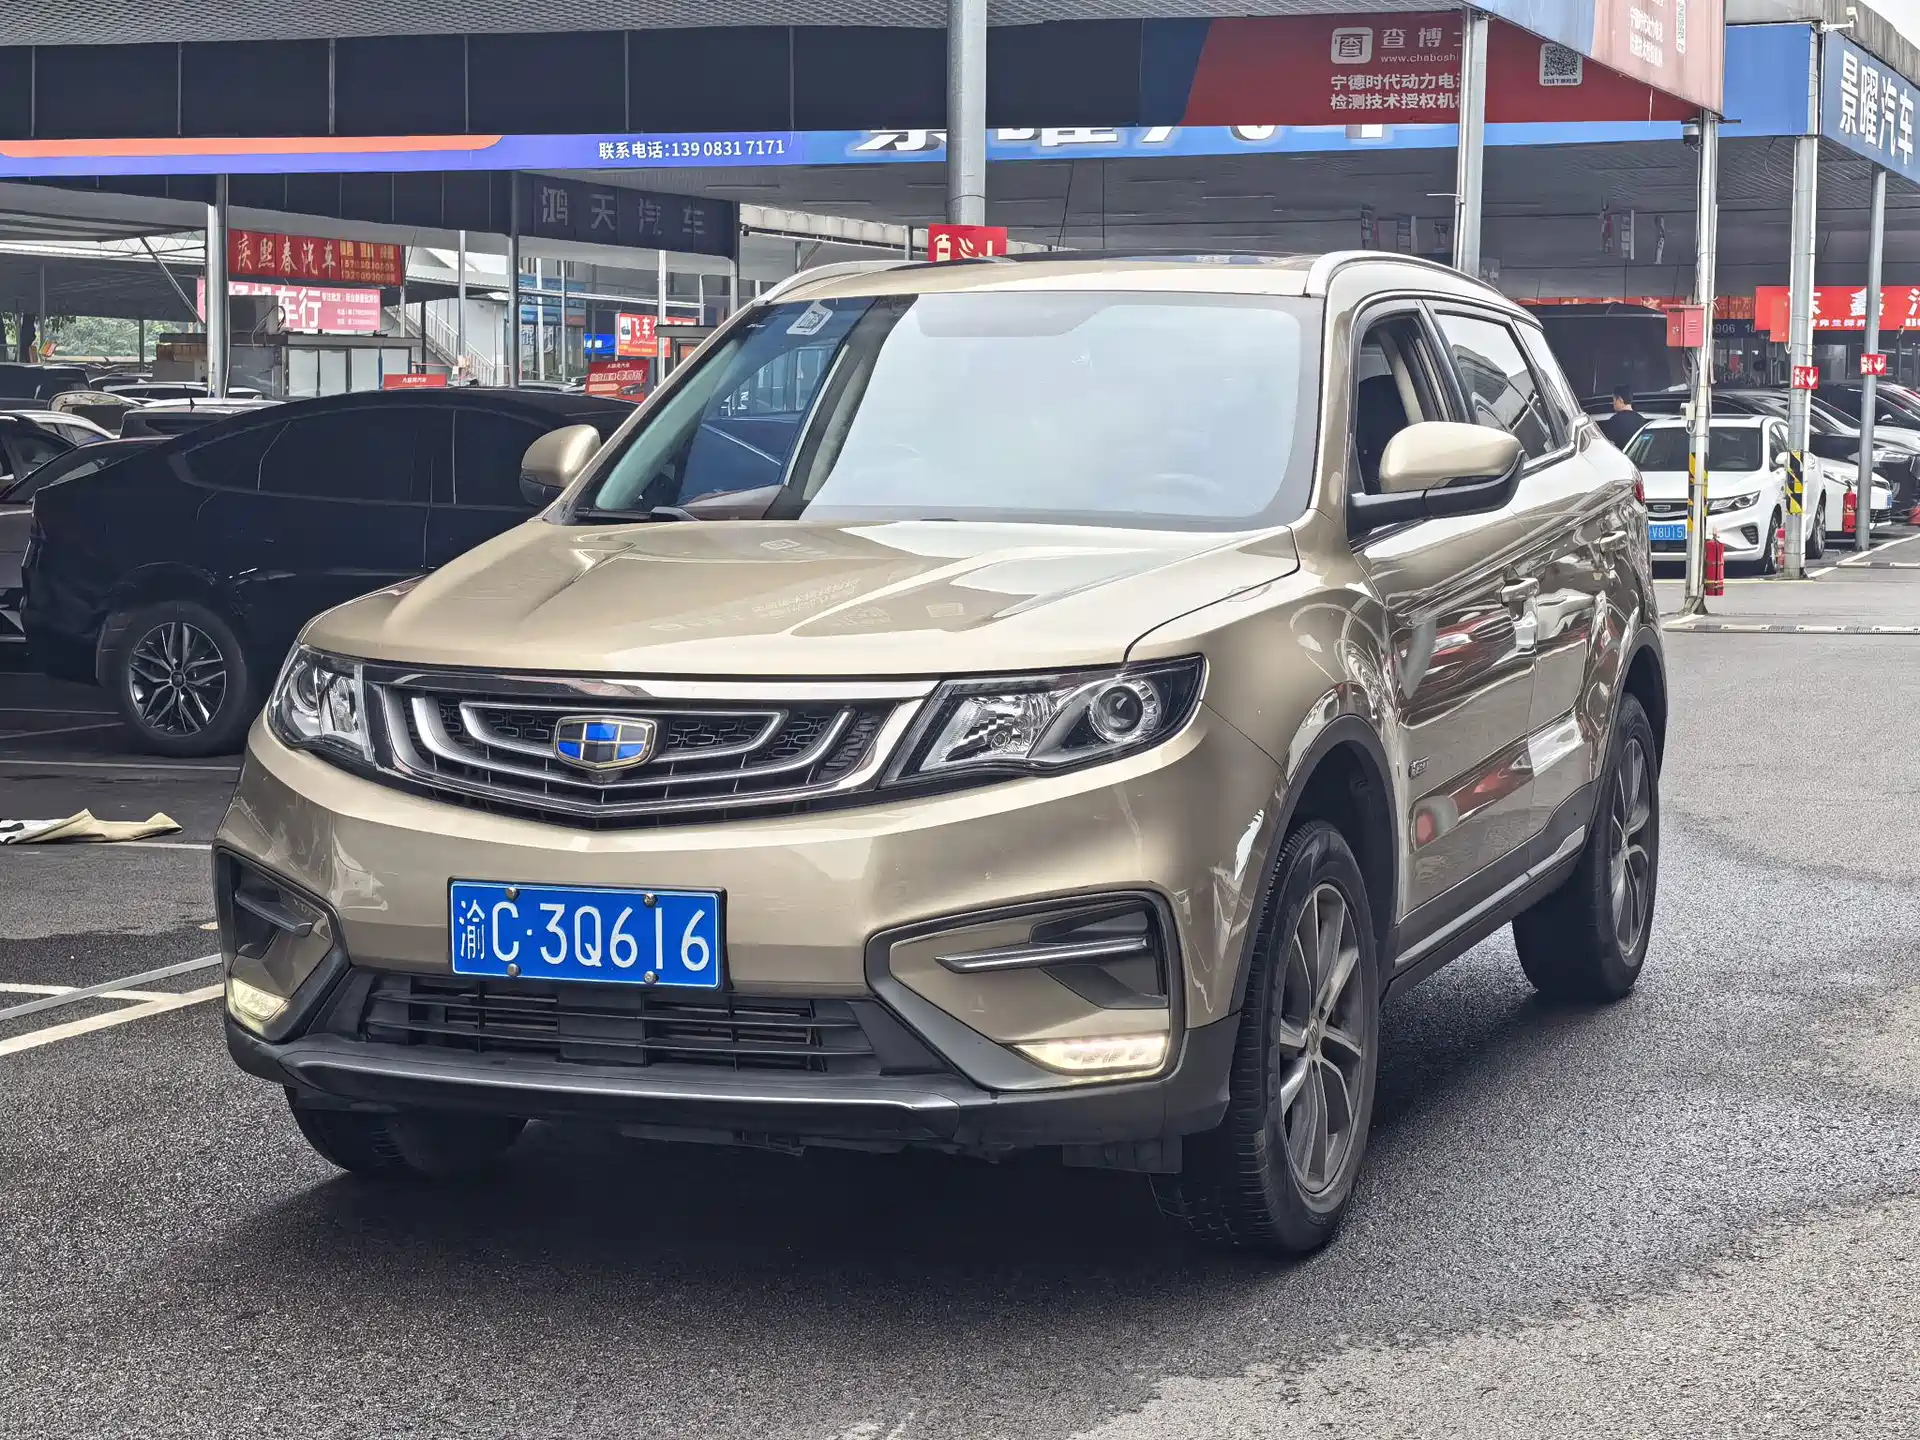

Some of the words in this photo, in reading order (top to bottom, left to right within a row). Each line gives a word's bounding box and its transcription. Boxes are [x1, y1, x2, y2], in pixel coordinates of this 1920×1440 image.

[1330, 73, 1460, 91] 宁德时代动力电
[1330, 93, 1460, 110] 检测技术授权机
[1840, 49, 1914, 165] 景曜汽车
[703, 140, 742, 157] 0831
[746, 139, 785, 156] 7171
[542, 185, 706, 236] 鸿天汽车
[459, 899, 710, 972] 渝C·3Q616
